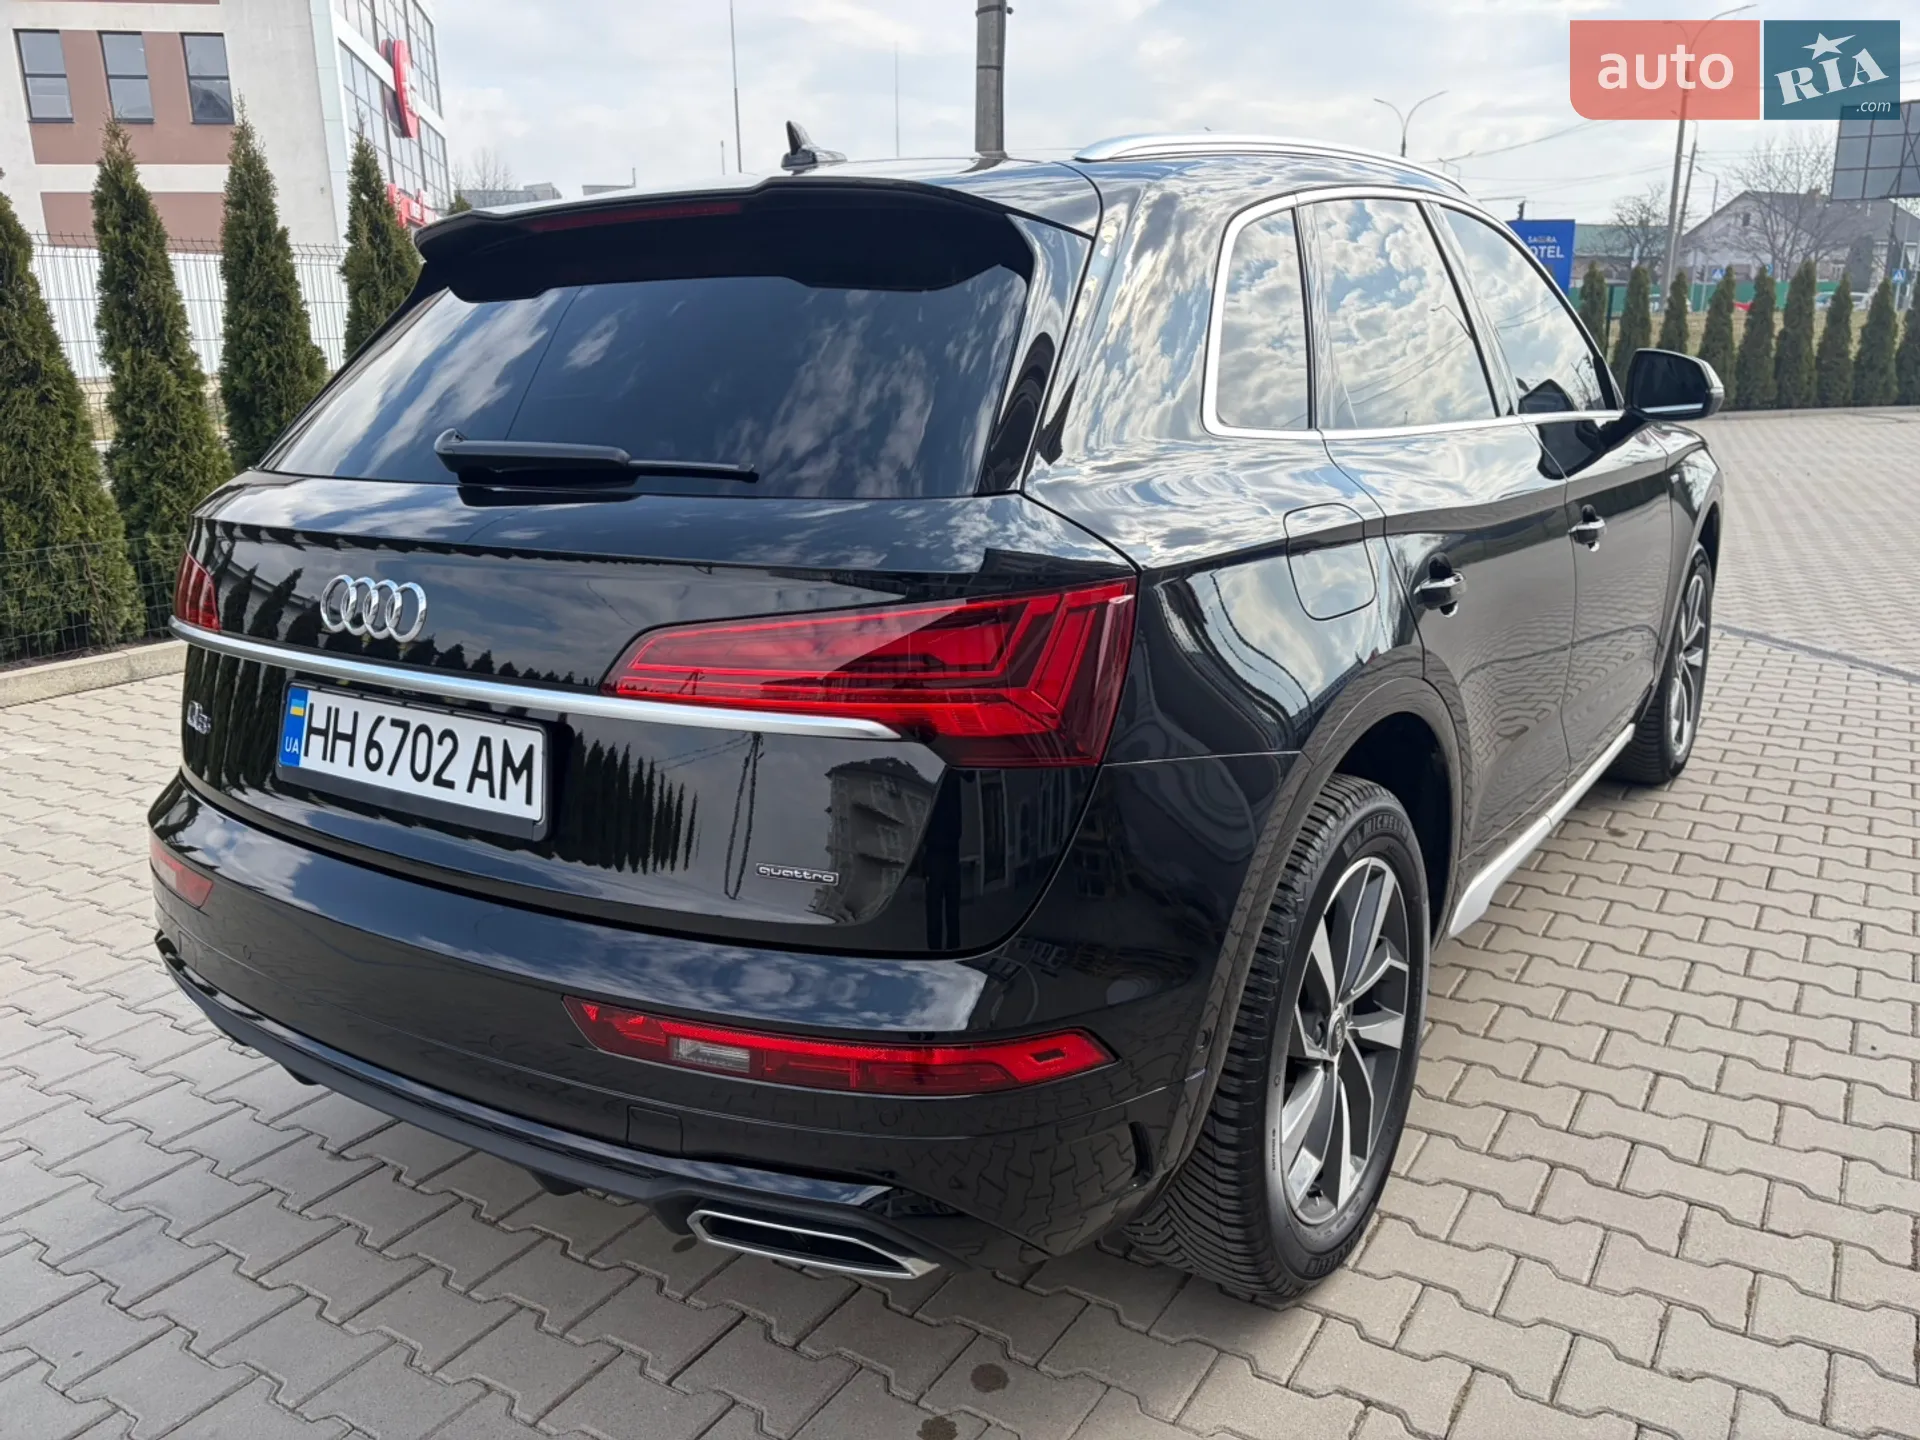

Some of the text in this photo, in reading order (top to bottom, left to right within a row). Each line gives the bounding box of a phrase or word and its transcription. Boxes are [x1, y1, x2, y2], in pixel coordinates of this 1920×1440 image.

[1529, 245, 1565, 258] OTEL
[284, 736, 300, 754] UA
[303, 702, 535, 806] HH 6702 AM
[758, 866, 835, 883] quattro
